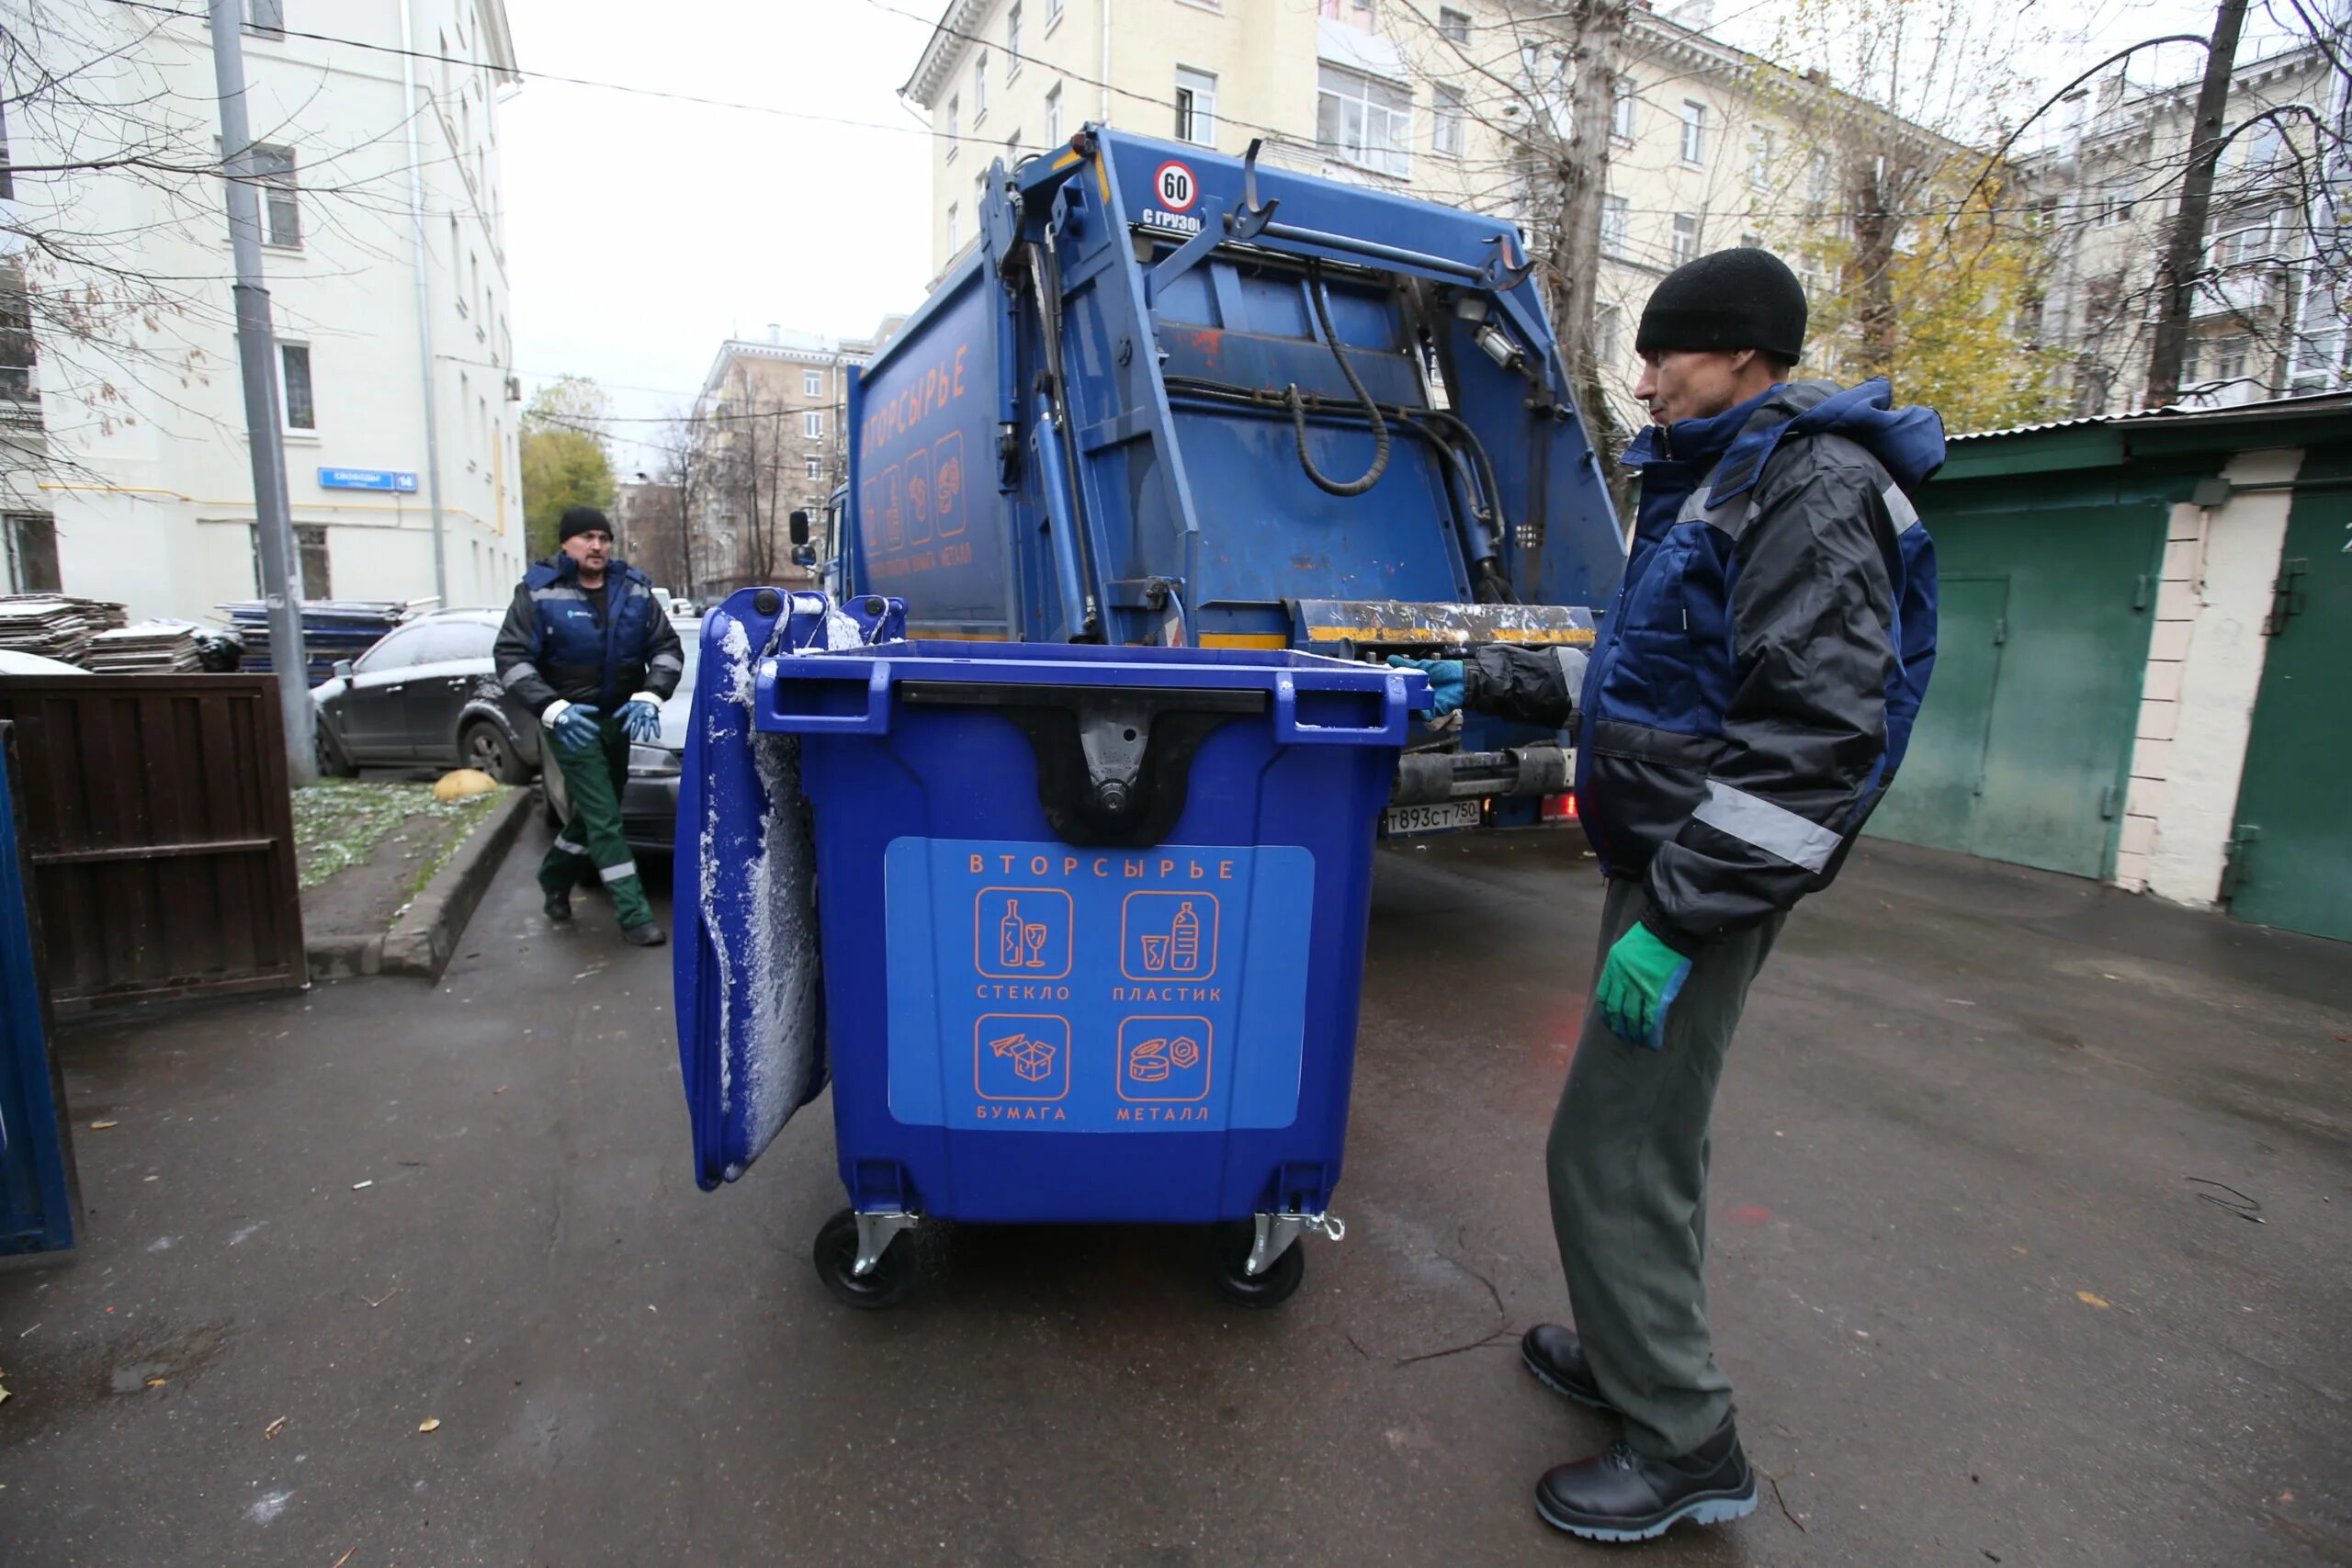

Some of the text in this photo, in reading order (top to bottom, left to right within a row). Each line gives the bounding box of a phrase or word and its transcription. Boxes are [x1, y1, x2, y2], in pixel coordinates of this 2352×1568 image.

[1164, 173, 1187, 200] 60
[1143, 208, 1153, 223] С
[862, 344, 968, 459] ВТОРСЫРЬЕ
[1453, 802, 1476, 818] 750
[969, 854, 1233, 879] ВТОРСЫРЬЕ
[977, 985, 1069, 1000] СТЕКЛО
[1113, 987, 1221, 1001] ПЛАСТИК
[977, 1106, 1066, 1120] БУМАГА
[1116, 1108, 1208, 1121] МЕТАЛЛ
